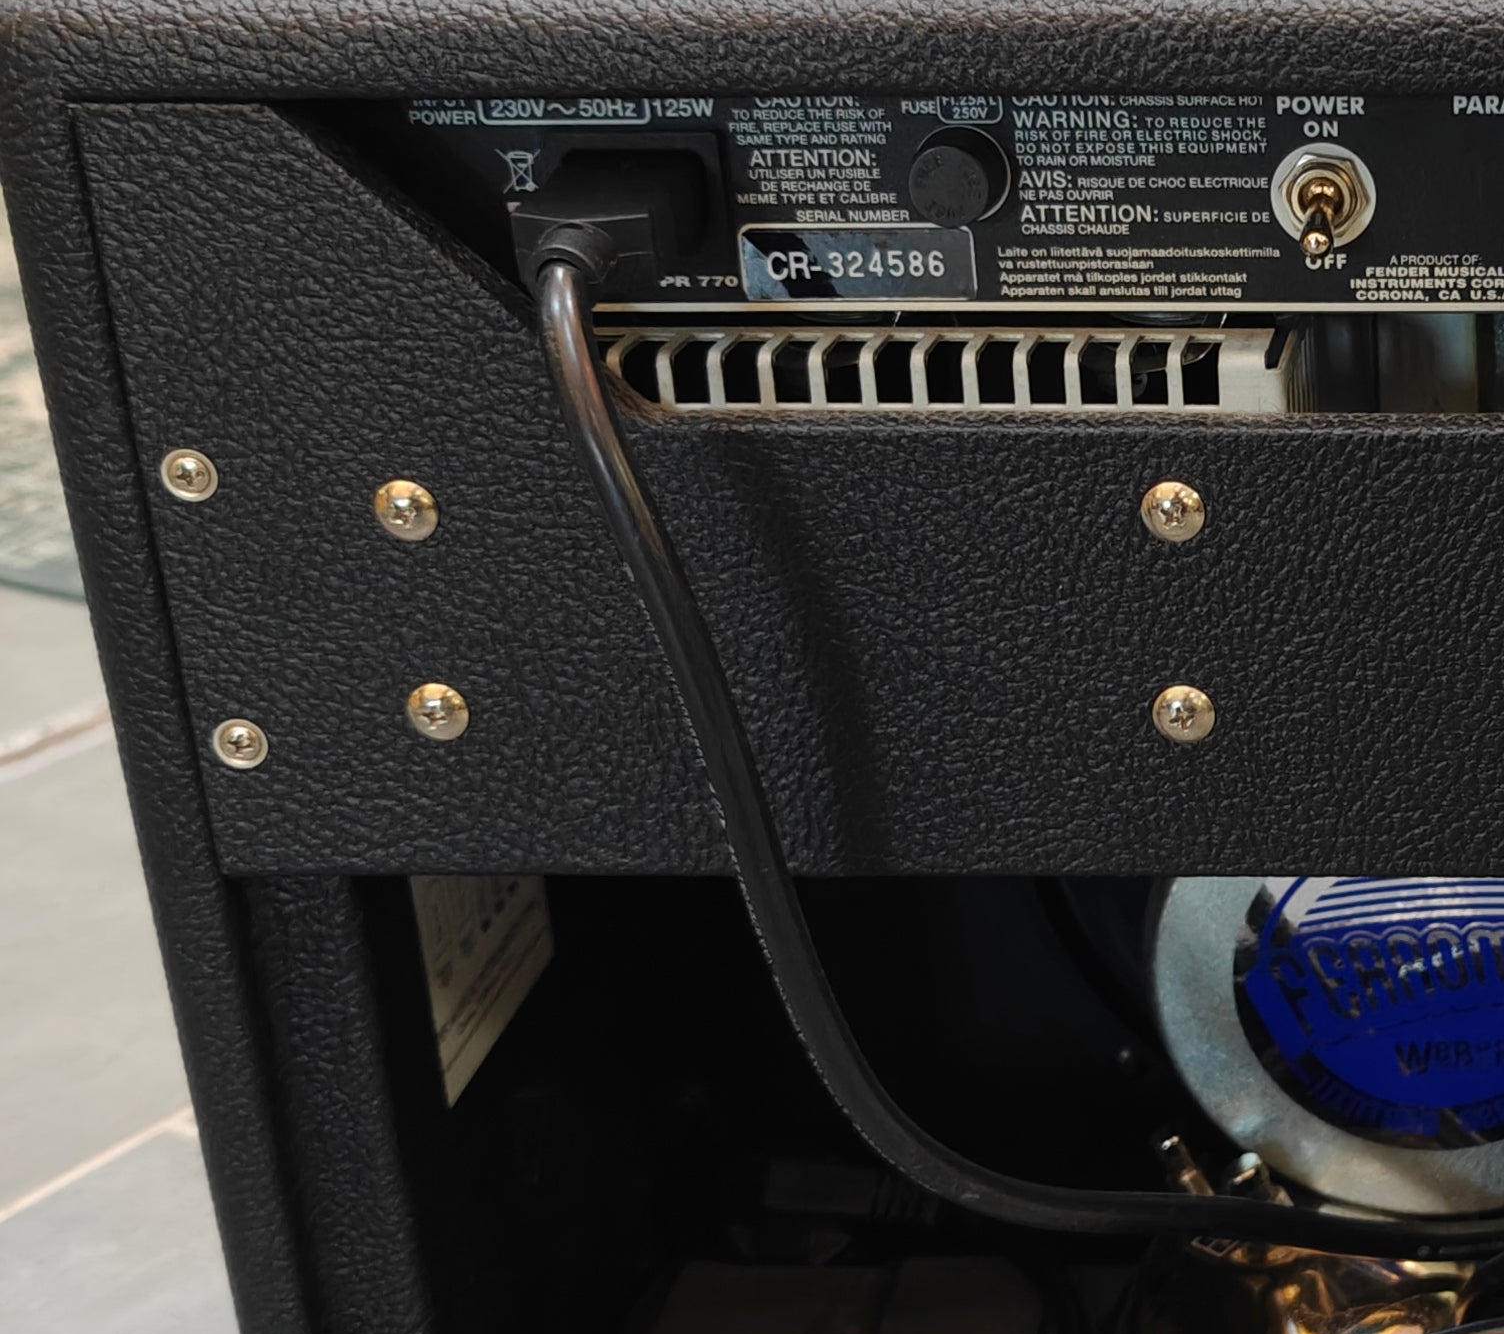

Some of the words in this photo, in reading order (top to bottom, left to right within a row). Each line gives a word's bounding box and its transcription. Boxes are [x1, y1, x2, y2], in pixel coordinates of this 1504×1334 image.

[1120, 96, 1174, 106] CHASSIS
[1178, 96, 1236, 106] SURFACE
[1276, 95, 1365, 115] POWER
[409, 110, 478, 125] POWER
[653, 98, 714, 117] 125W
[901, 100, 936, 115] FUSE
[952, 107, 988, 119] 250V
[733, 109, 749, 120] TO
[753, 109, 804, 120] REDUCE
[810, 109, 832, 120] THE
[835, 109, 864, 120] RISK
[868, 108, 885, 119] OF
[1013, 111, 1138, 128] WARNING:
[1145, 118, 1165, 128] TO
[1170, 117, 1232, 128] REDUCE
[1238, 117, 1266, 128] THE
[729, 122, 759, 133] FIRE,
[764, 122, 820, 133] REPLACE
[824, 121, 857, 133] FUSE
[860, 121, 892, 132] WITH
[1303, 121, 1339, 137] ON
[737, 134, 773, 146] SAME
[777, 134, 808, 146] TYPE
[811, 134, 837, 145] AND
[840, 134, 886, 145] RATING
[1015, 130, 1048, 141] RISK
[1052, 130, 1071, 141] OF
[1076, 130, 1107, 141] FIRE
[1111, 130, 1132, 141] OR
[1137, 130, 1207, 141] ELECTRIC
[1212, 130, 1267, 142] SHOCK,
[1016, 143, 1037, 154] DO
[1041, 143, 1070, 154] NOT
[1076, 143, 1135, 154] EXPOSE
[1140, 143, 1173, 154] THIS
[1179, 143, 1267, 154] EQUIPMENT
[750, 149, 877, 167] ATTENTION:
[1016, 156, 1033, 166] TO
[1037, 156, 1066, 166] RAIN
[1069, 156, 1087, 166] OR
[1090, 156, 1155, 166] MOISTURE
[750, 168, 804, 179] UTILISER
[807, 168, 826, 179] UN
[829, 168, 881, 179] FUSIBLE
[1018, 171, 1073, 189] AVIS:
[1077, 178, 1125, 189] RISQUE
[1129, 178, 1145, 188] DE
[1149, 178, 1185, 188] CHOC
[1189, 178, 1269, 189] ELECTRIQUE
[761, 181, 778, 192] DE
[781, 181, 850, 192] RECHANGE
[854, 181, 871, 192] DE
[738, 193, 778, 204] MEME
[781, 193, 815, 204] TYPE
[820, 193, 835, 204] ET
[840, 193, 897, 204] CALIBRE
[1019, 190, 1036, 201] NE
[1039, 190, 1064, 201] PAS
[1066, 190, 1114, 201] OUVRIR
[796, 210, 846, 222] SERIAL
[849, 210, 910, 222] NUMBER
[1020, 205, 1159, 223] ATTENTION:
[1163, 212, 1248, 223] SUPERFICIE
[1252, 212, 1270, 222] DE
[1021, 224, 1075, 235] CHASSIS
[1078, 224, 1130, 235] CHAUDE
[998, 247, 1028, 257] Laite
[1031, 249, 1047, 257] on
[1305, 253, 1347, 270] OFF
[1390, 255, 1397, 265] A
[1400, 255, 1459, 265] PRODUCT
[1462, 255, 1482, 265] OF:
[1365, 267, 1430, 277] FENDER
[696, 275, 739, 288] 770
[1000, 272, 1060, 285] Apparatet
[1140, 272, 1177, 285] jordet
[1180, 272, 1247, 283] stikkontakt
[1350, 279, 1466, 289] INSTRUMENTS
[1001, 285, 1064, 298] Apparaten
[1068, 285, 1096, 296] skall
[1100, 285, 1150, 296] anslutas
[1153, 285, 1168, 296] till
[1171, 285, 1207, 298] jordat
[1210, 286, 1241, 298] uttag
[1356, 290, 1430, 302] CORONA,
[1438, 290, 1461, 301] CA
